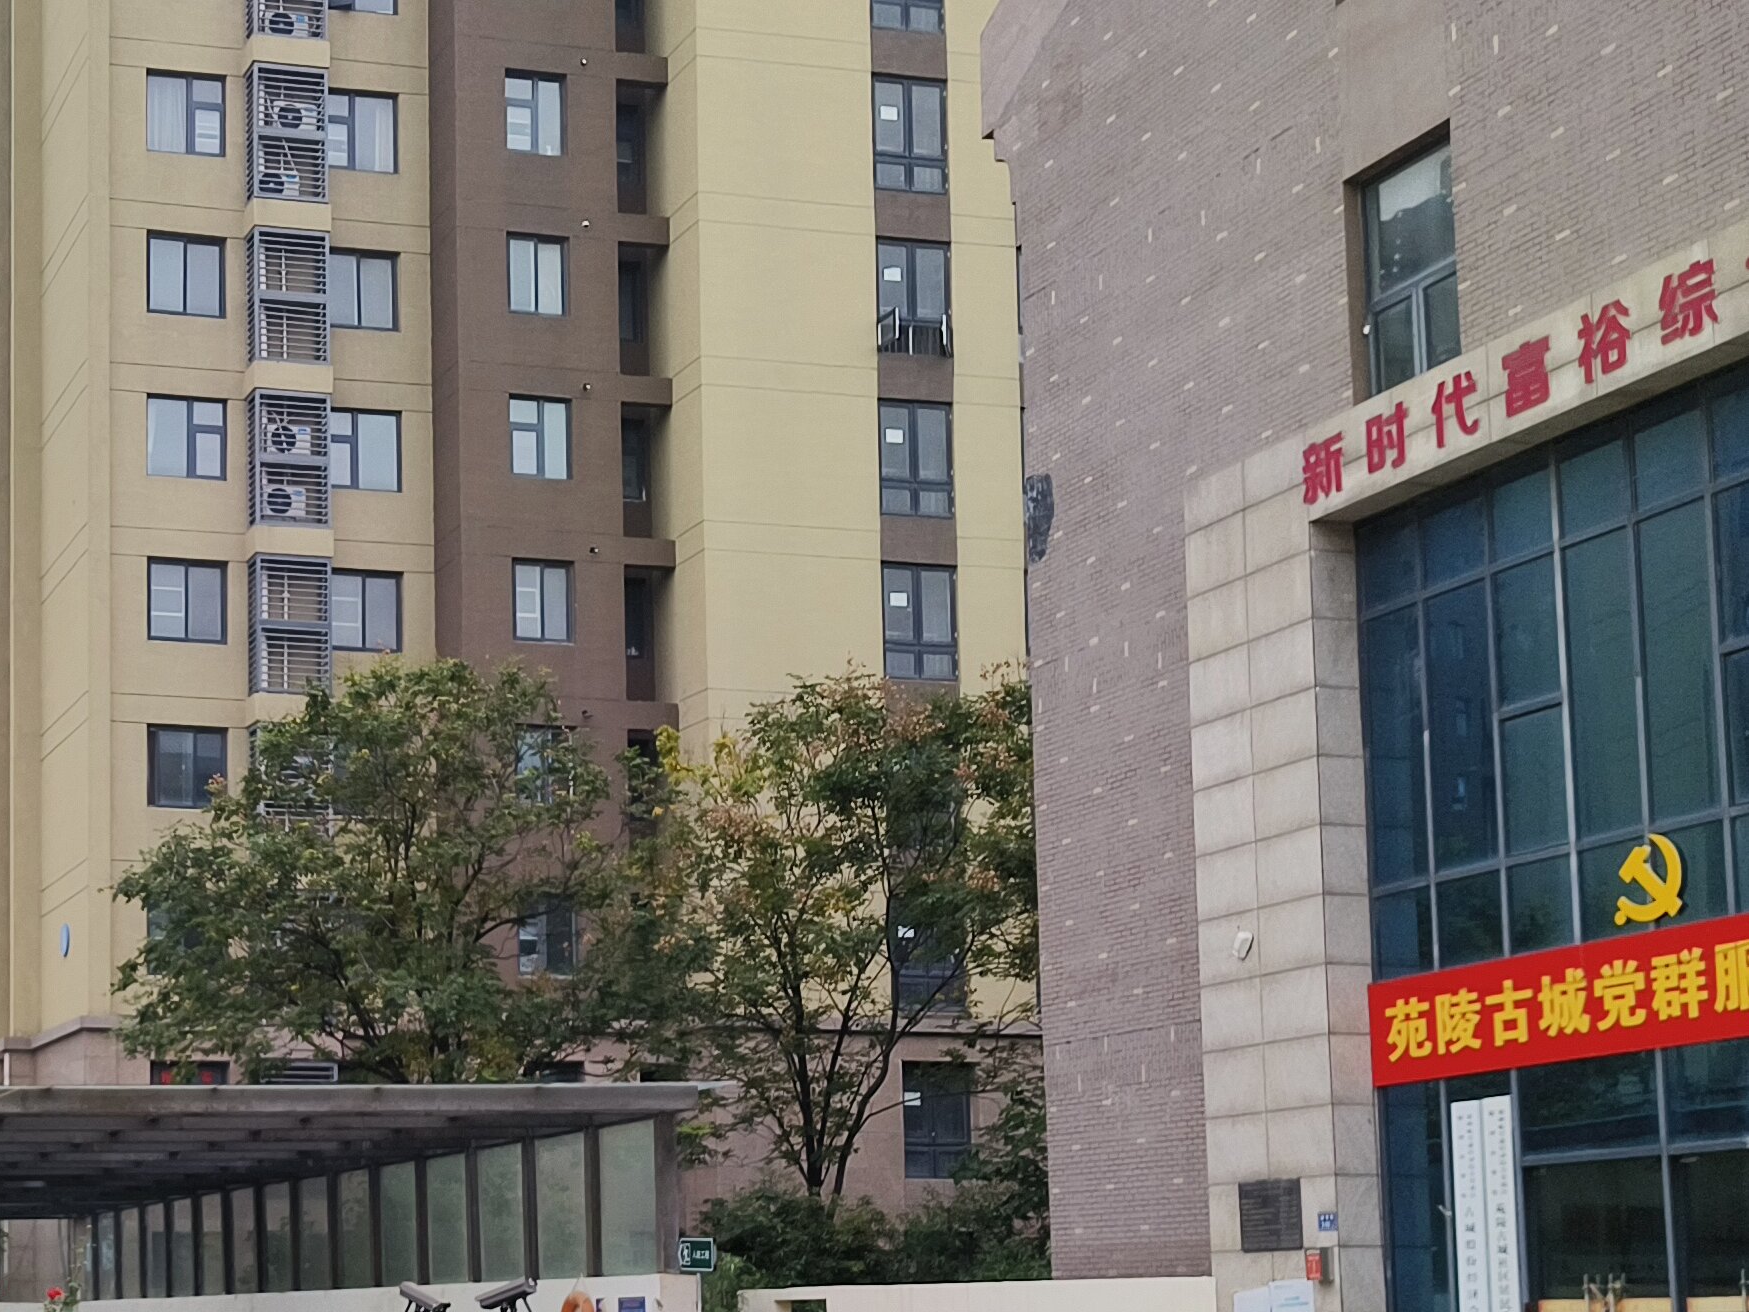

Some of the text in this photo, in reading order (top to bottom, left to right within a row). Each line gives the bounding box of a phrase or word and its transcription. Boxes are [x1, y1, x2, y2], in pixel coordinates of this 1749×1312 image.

[1302, 257, 1749, 504] 新时代富裕综
[1385, 938, 1749, 1063] 苑陵古城党群服
